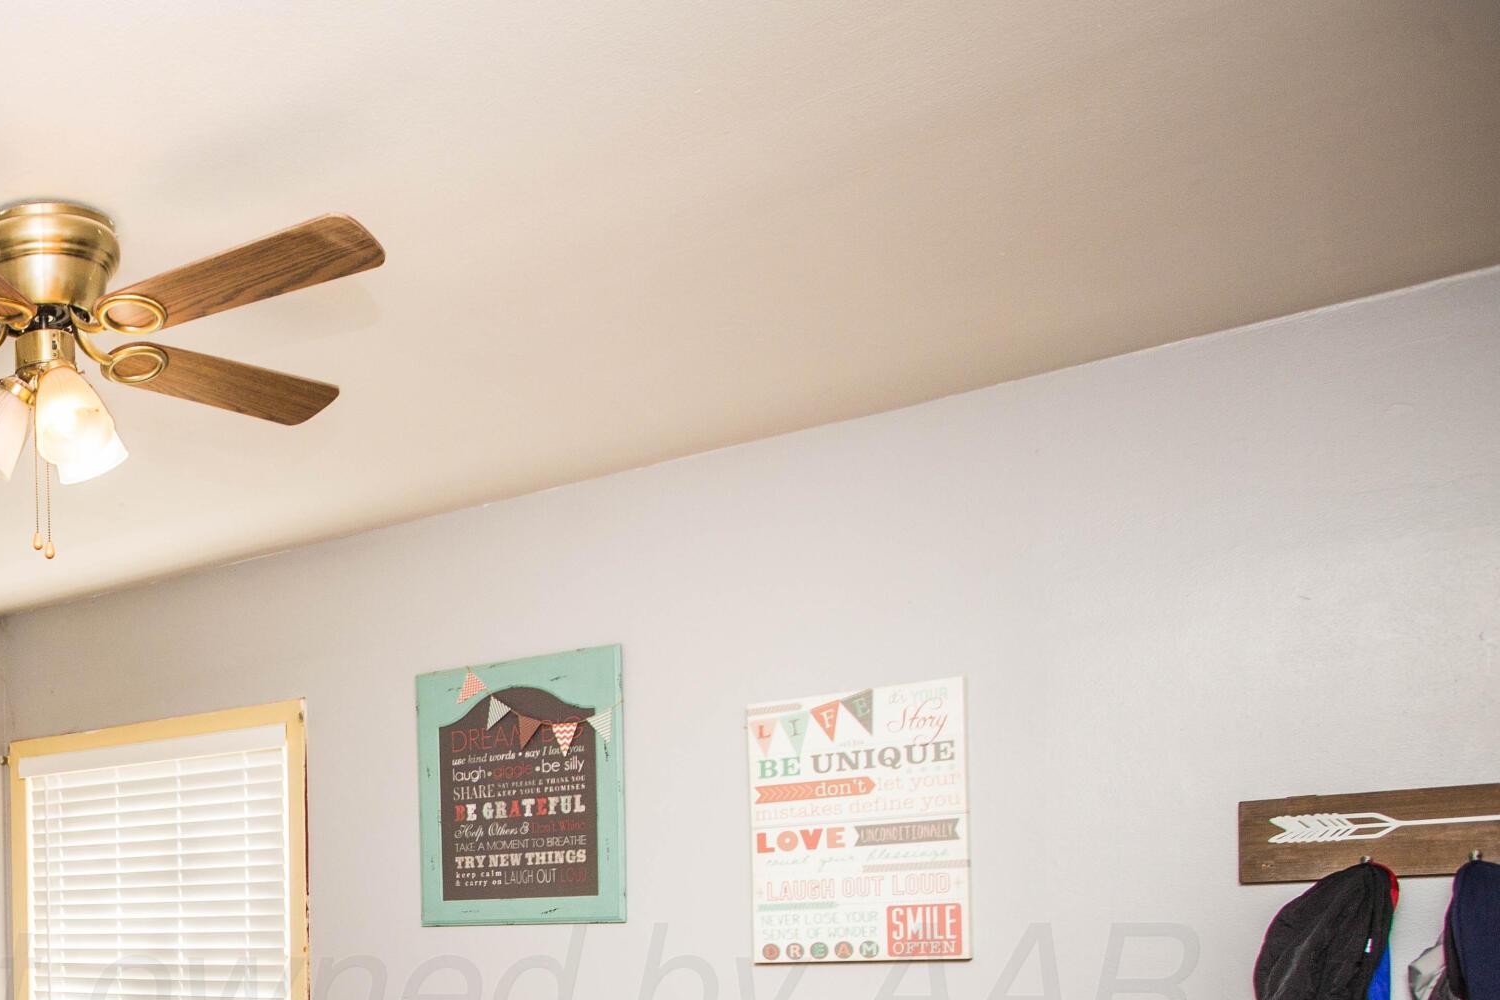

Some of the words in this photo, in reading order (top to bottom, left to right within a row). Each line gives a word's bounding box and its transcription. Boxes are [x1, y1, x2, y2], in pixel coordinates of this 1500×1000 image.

[887, 697, 948, 746] Story
[468, 754, 487, 764] kind
[489, 750, 516, 759] words
[524, 749, 540, 759] say
[569, 745, 585, 756] you
[758, 757, 800, 779] BE
[810, 740, 955, 774] UNIQUE
[452, 766, 486, 782] laugh
[541, 759, 560, 773] be
[564, 756, 586, 773] silly
[571, 774, 586, 782] YOU
[453, 783, 496, 801] SHARE
[544, 783, 586, 794] PROMISES
[815, 779, 868, 797] don't
[454, 803, 477, 822] BE
[482, 794, 586, 820] GRATEFUL
[454, 823, 484, 842] Help
[488, 822, 518, 836] Others
[757, 827, 845, 853] LOVE
[860, 821, 951, 843] UNCONDITIONALLY
[454, 842, 476, 853] TAKE
[477, 841, 486, 851] A
[486, 839, 530, 851] MOMENT
[531, 838, 545, 849] TO
[546, 835, 587, 847] BREATHE
[455, 855, 486, 869] TRY
[488, 853, 522, 868] NEW
[525, 849, 586, 866] THINGS
[455, 871, 476, 880] keep
[480, 869, 502, 879] calm
[504, 869, 534, 885] LAUGH
[536, 868, 556, 883] OUT
[767, 877, 836, 902] LAUGH
[842, 876, 885, 898] OUT
[892, 873, 950, 896] LOUD
[805, 912, 837, 925] LOSE
[845, 910, 878, 924] YOUR
[892, 904, 957, 941] SMILE
[828, 926, 879, 939] WONDER
[764, 942, 879, 959] DREAM
[893, 940, 957, 955] OFTEN
